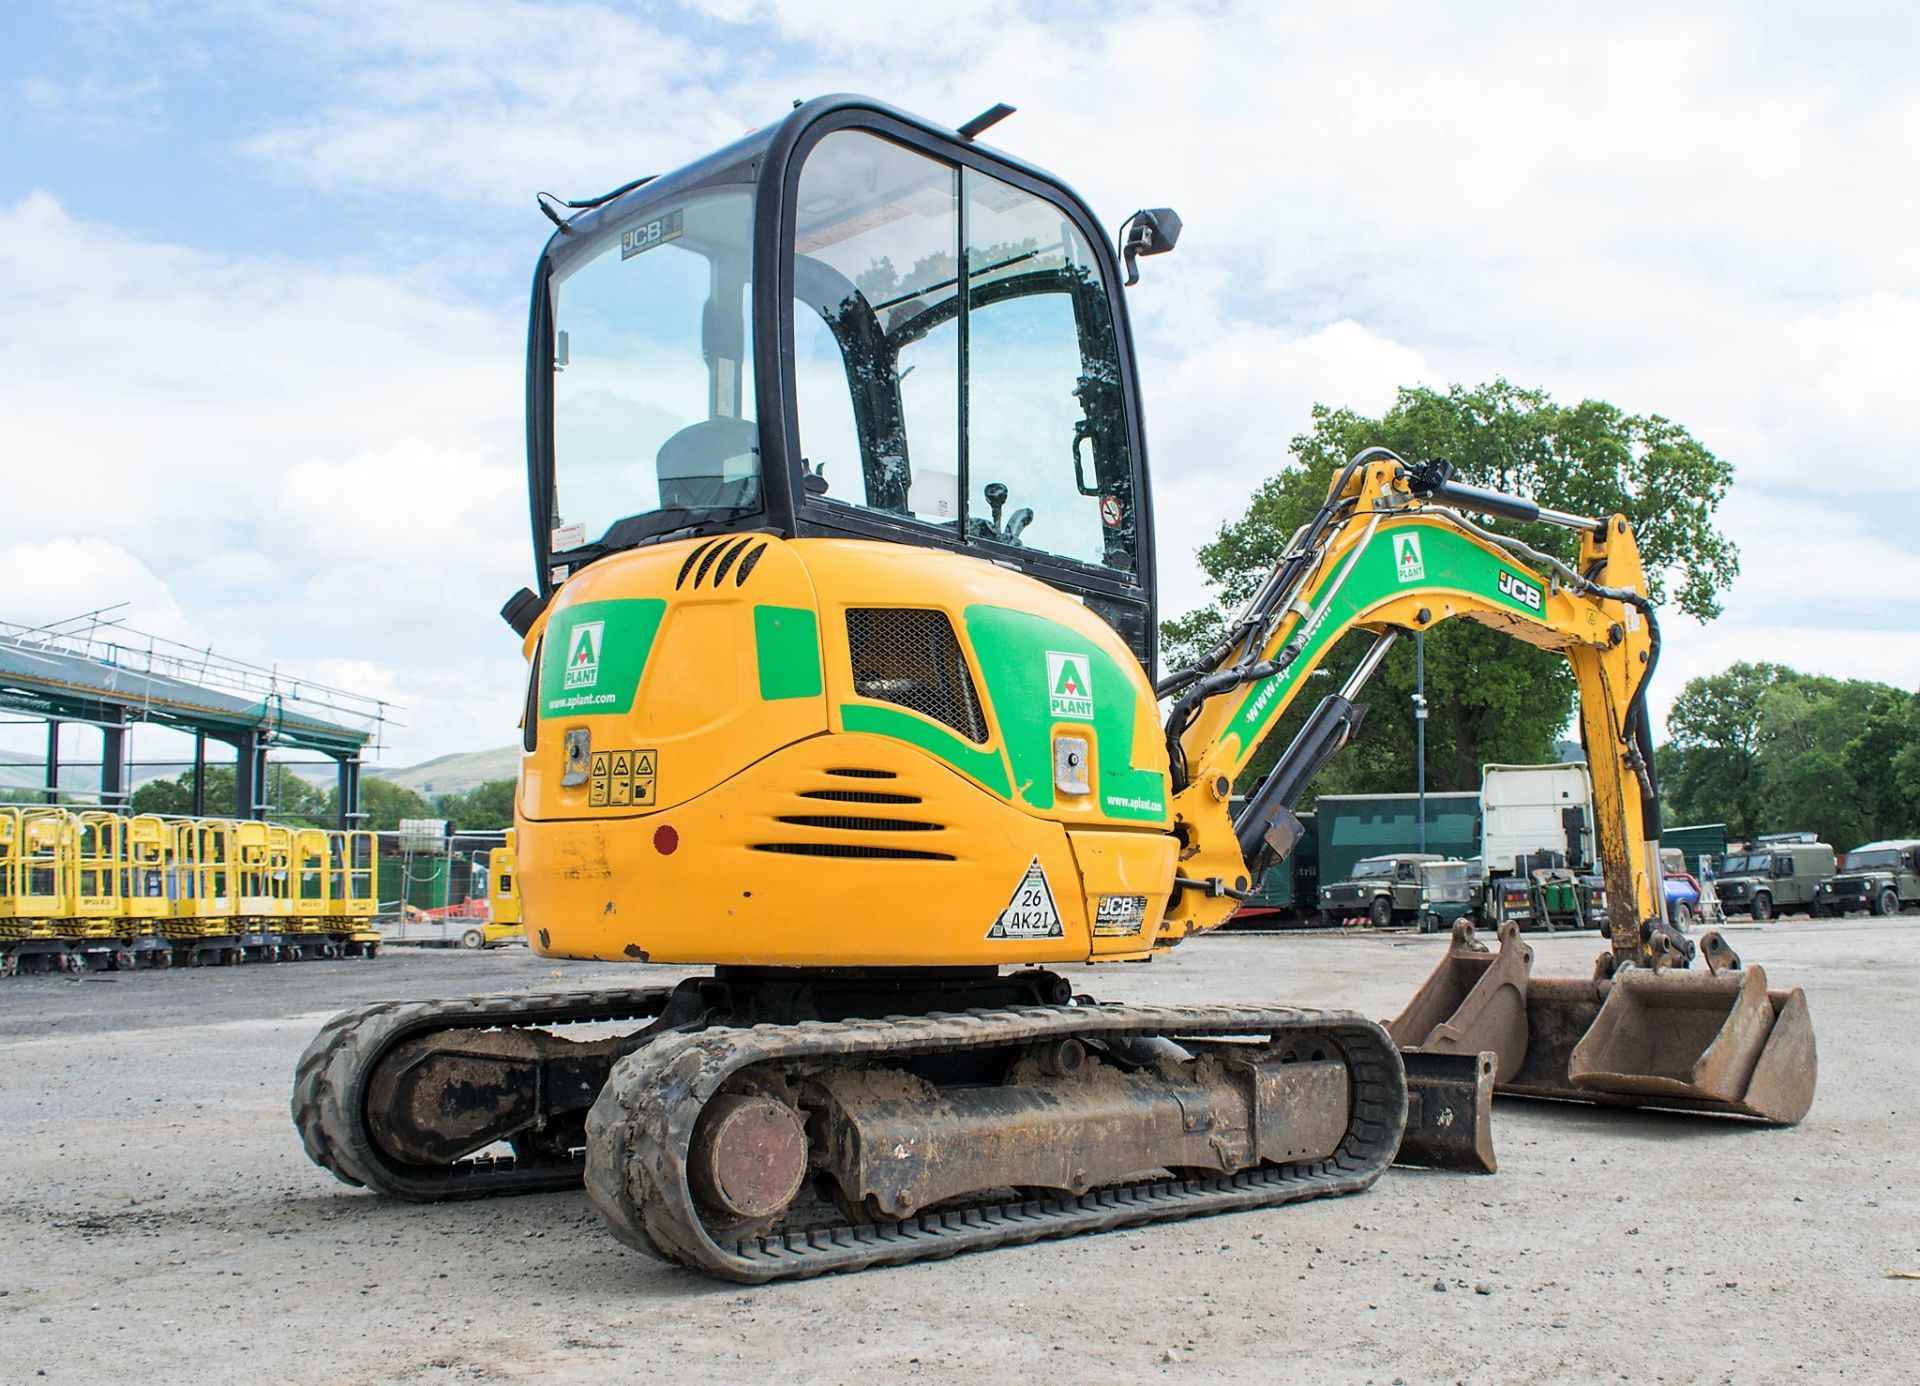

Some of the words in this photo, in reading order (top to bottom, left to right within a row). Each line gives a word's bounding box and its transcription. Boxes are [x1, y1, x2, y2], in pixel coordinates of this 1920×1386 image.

[623, 221, 661, 252] JCB
[1399, 538, 1419, 566] A
[1399, 566, 1423, 578] PLANT
[1499, 575, 1541, 610] JCB
[570, 629, 596, 667] A
[567, 669, 596, 685] PLANT
[1055, 659, 1089, 697] A
[548, 693, 616, 710] www.aplant.com
[1052, 699, 1092, 715] PLANT
[1107, 794, 1162, 812] www.aplant.com
[1022, 890, 1042, 907] 26
[1098, 897, 1133, 915] JCB
